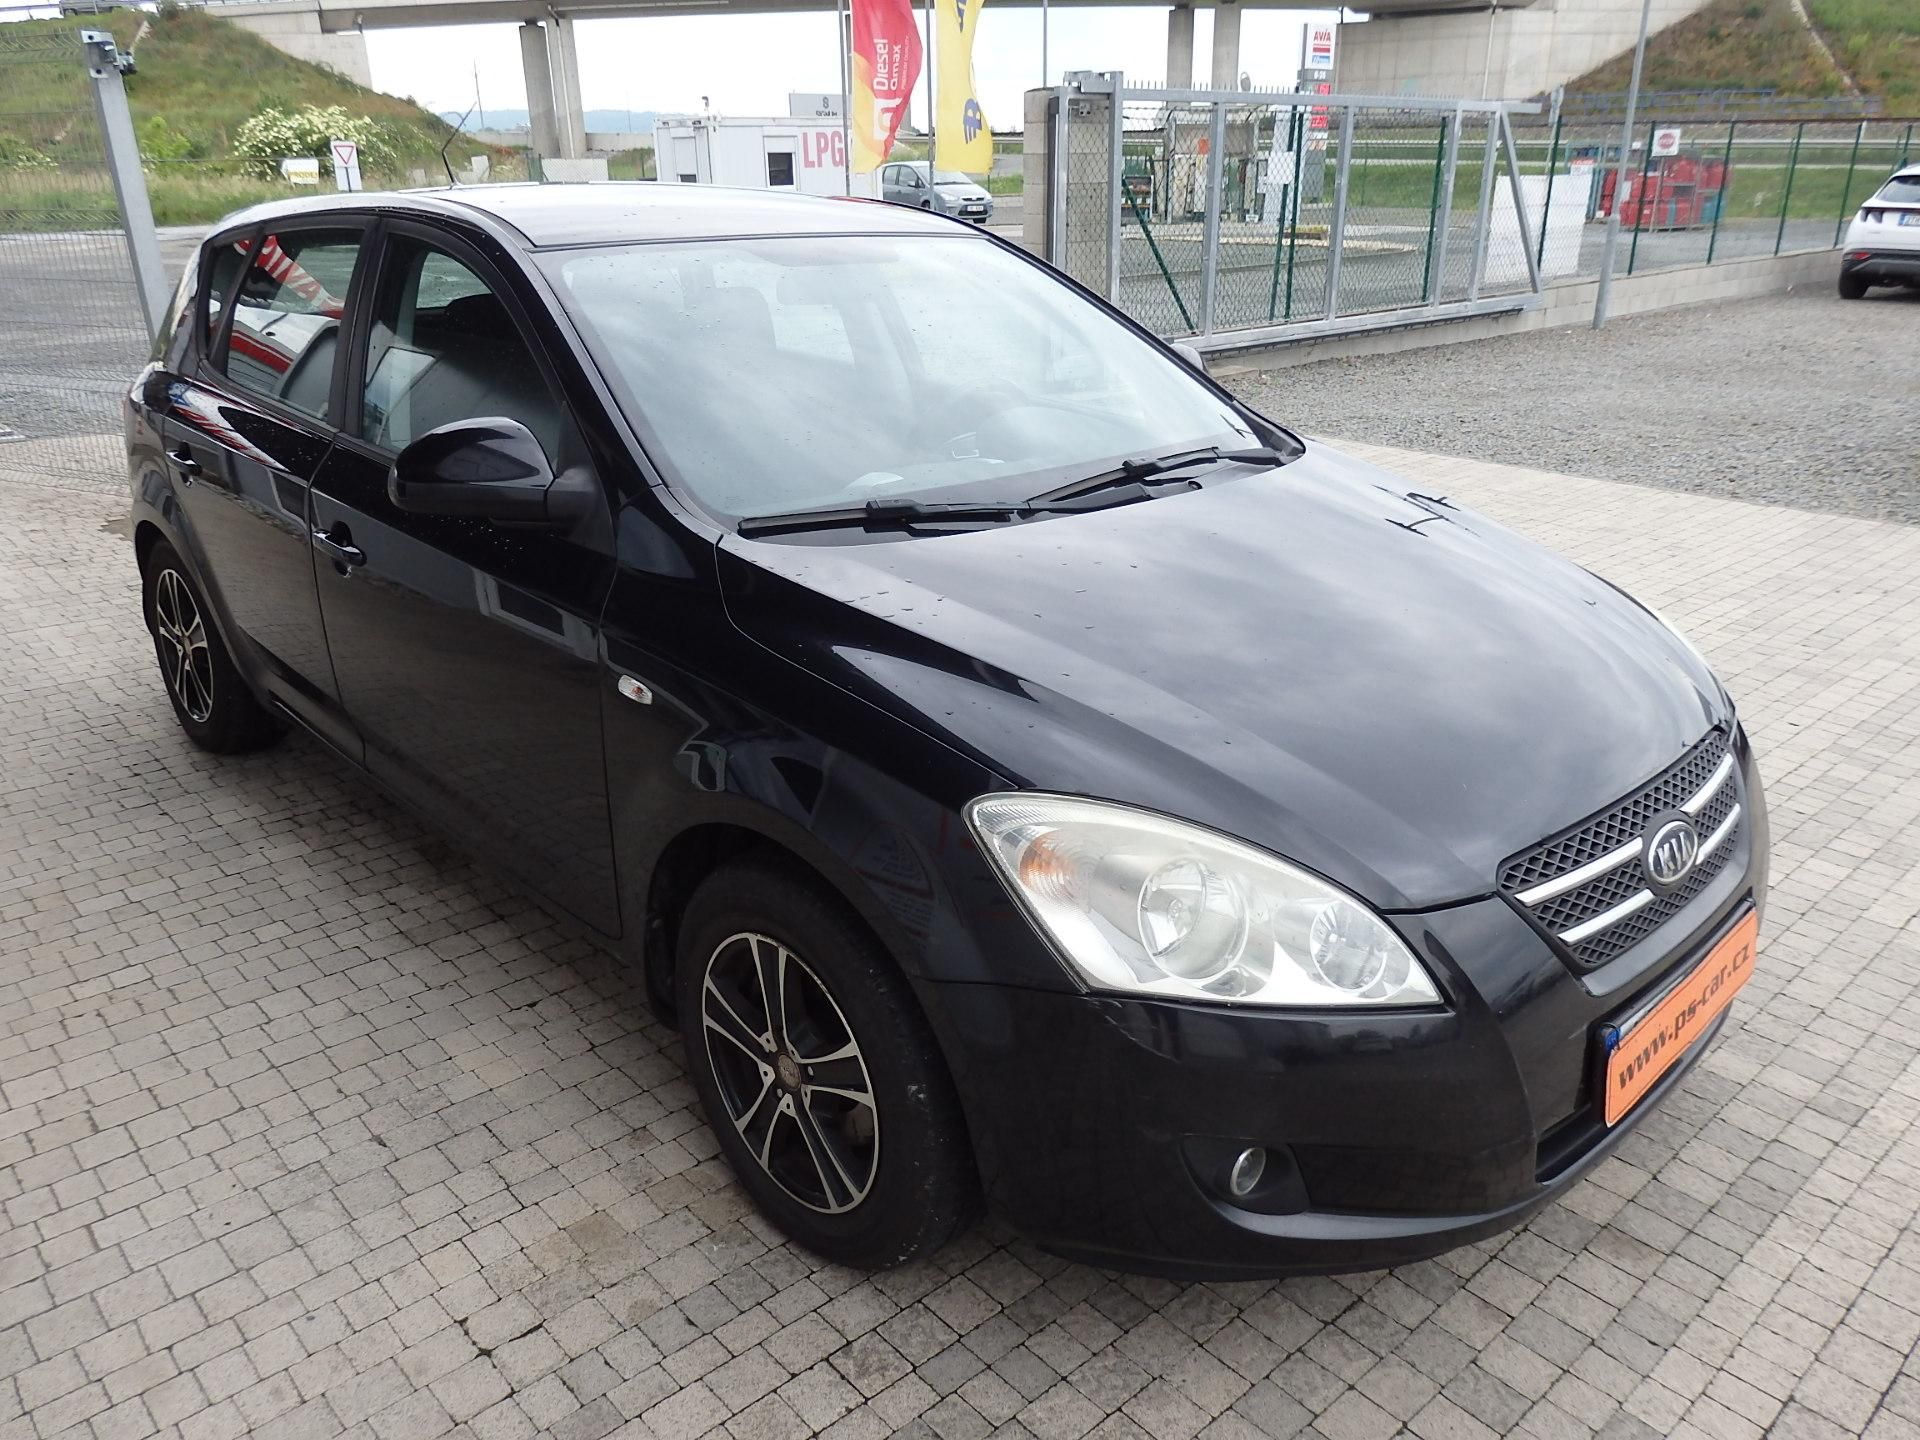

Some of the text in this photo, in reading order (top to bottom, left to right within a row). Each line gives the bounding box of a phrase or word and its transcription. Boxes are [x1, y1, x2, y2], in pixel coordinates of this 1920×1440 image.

[1313, 29, 1331, 41] AVIA
[873, 38, 889, 91] Diesel
[802, 131, 845, 168] LPG
[1619, 943, 1750, 1090] www.ps-car.cz
